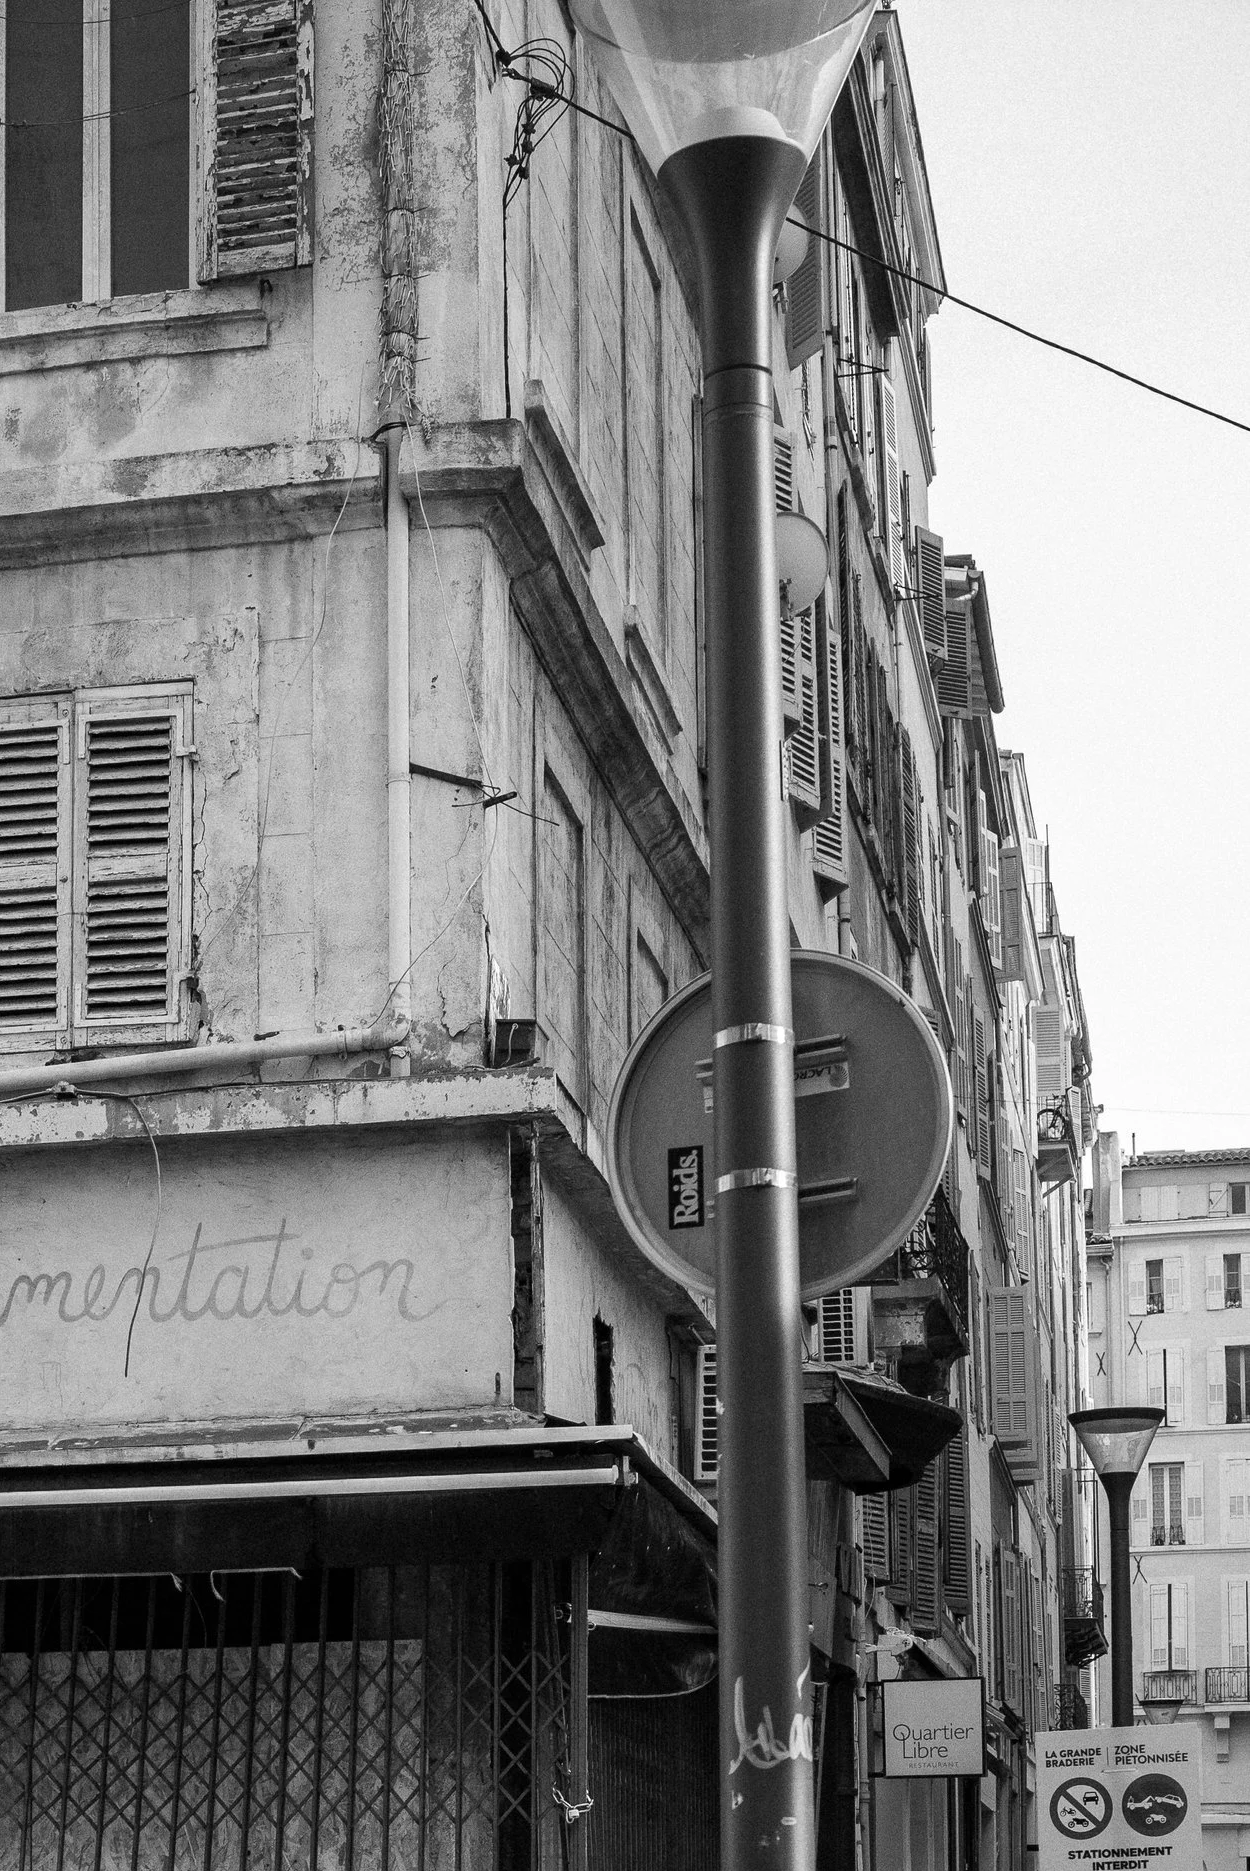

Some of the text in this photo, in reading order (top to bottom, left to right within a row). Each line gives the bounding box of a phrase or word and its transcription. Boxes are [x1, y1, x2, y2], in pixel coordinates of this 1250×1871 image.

[672, 1149, 699, 1227] Roids.
[892, 1722, 975, 1742] Quartier
[903, 1740, 949, 1759] Libre
[1045, 1747, 1102, 1760] LA GRANDE
[1114, 1744, 1146, 1755] ZONE
[908, 1761, 959, 1769] RESTAURANT
[1045, 1757, 1095, 1768] BRADERIE
[1115, 1751, 1189, 1766] PIÉTONNISÉE
[1067, 1846, 1173, 1860] STATIONNEMENT
[1092, 1860, 1149, 1871] INTERDIT
